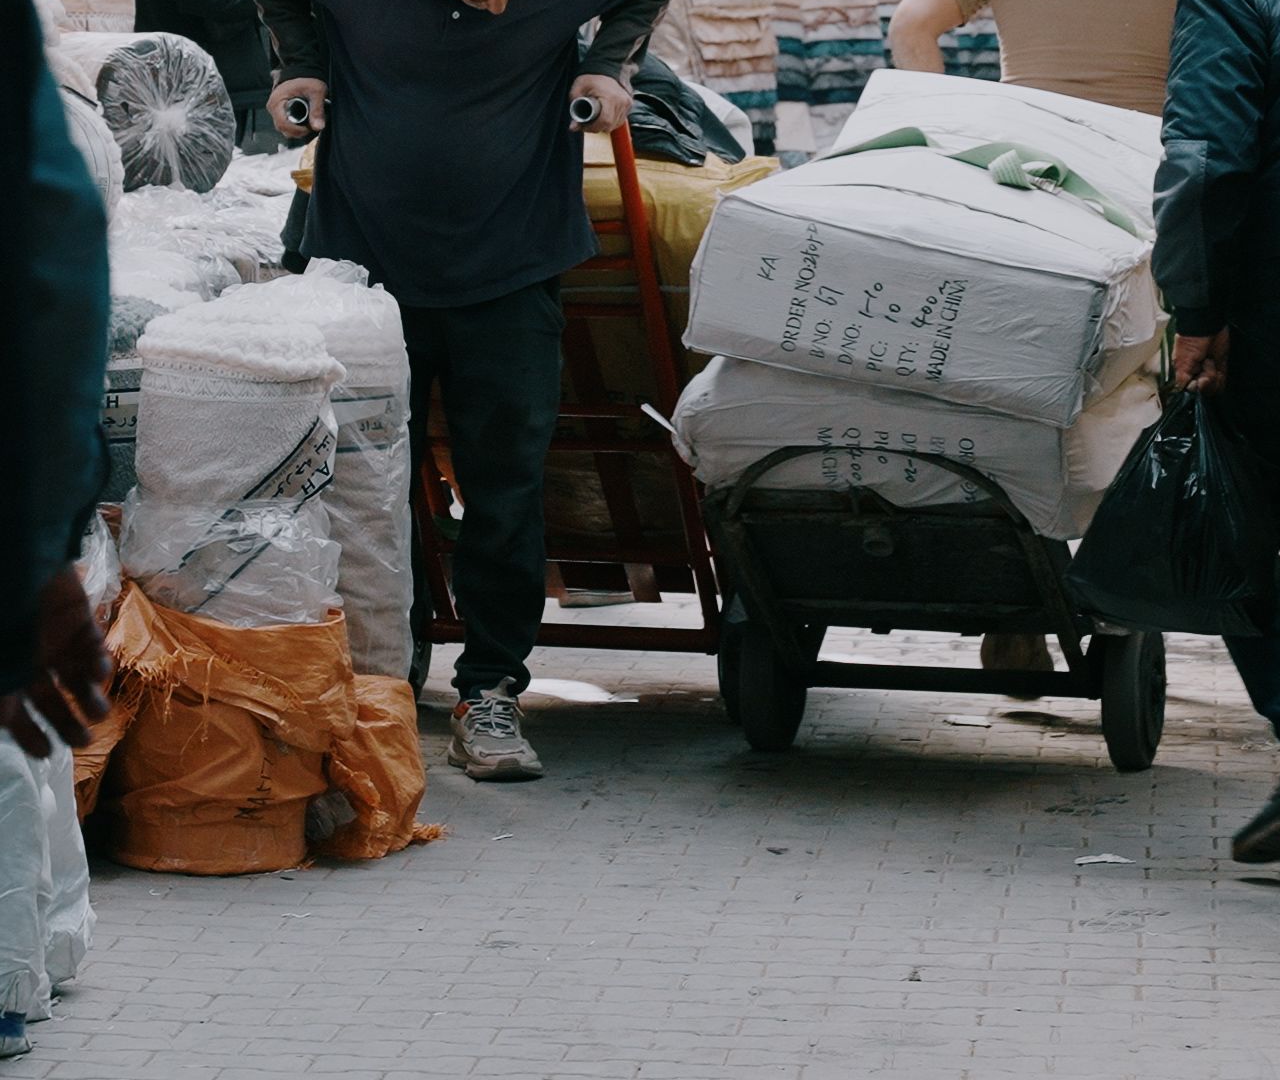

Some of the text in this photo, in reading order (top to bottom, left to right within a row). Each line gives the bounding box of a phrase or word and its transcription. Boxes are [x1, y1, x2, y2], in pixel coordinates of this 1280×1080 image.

[780, 297, 808, 353] ORDER
[837, 323, 862, 366] D/NO:
[924, 279, 969, 383] MADE IN CHINA
[866, 340, 888, 372] PIC:
[896, 342, 919, 377] QTY:
